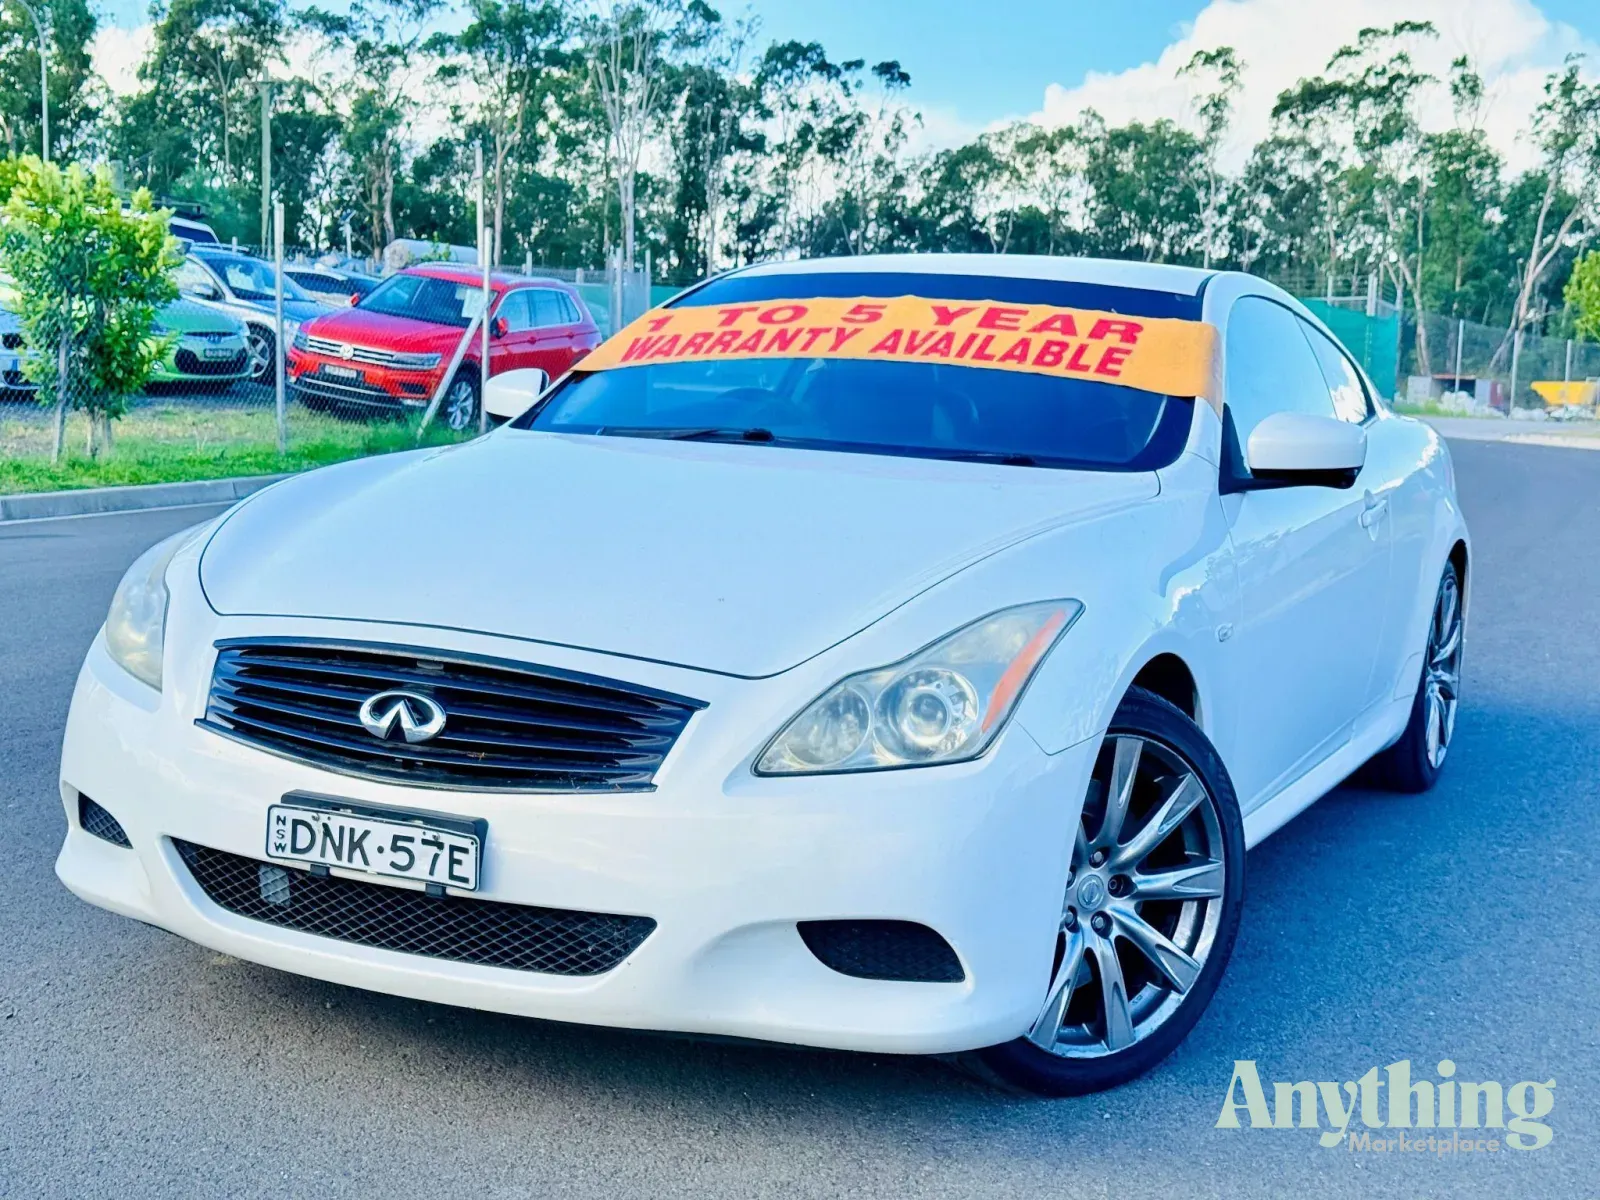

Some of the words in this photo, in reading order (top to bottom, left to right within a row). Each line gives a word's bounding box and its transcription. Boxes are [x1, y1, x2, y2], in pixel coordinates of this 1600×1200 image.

[648, 315, 673, 333] 1
[717, 304, 809, 326] TO
[840, 304, 887, 324] 5
[930, 306, 1145, 345] YEAR
[620, 327, 863, 362] WARRANTY
[868, 329, 1134, 377] AVAILABLE
